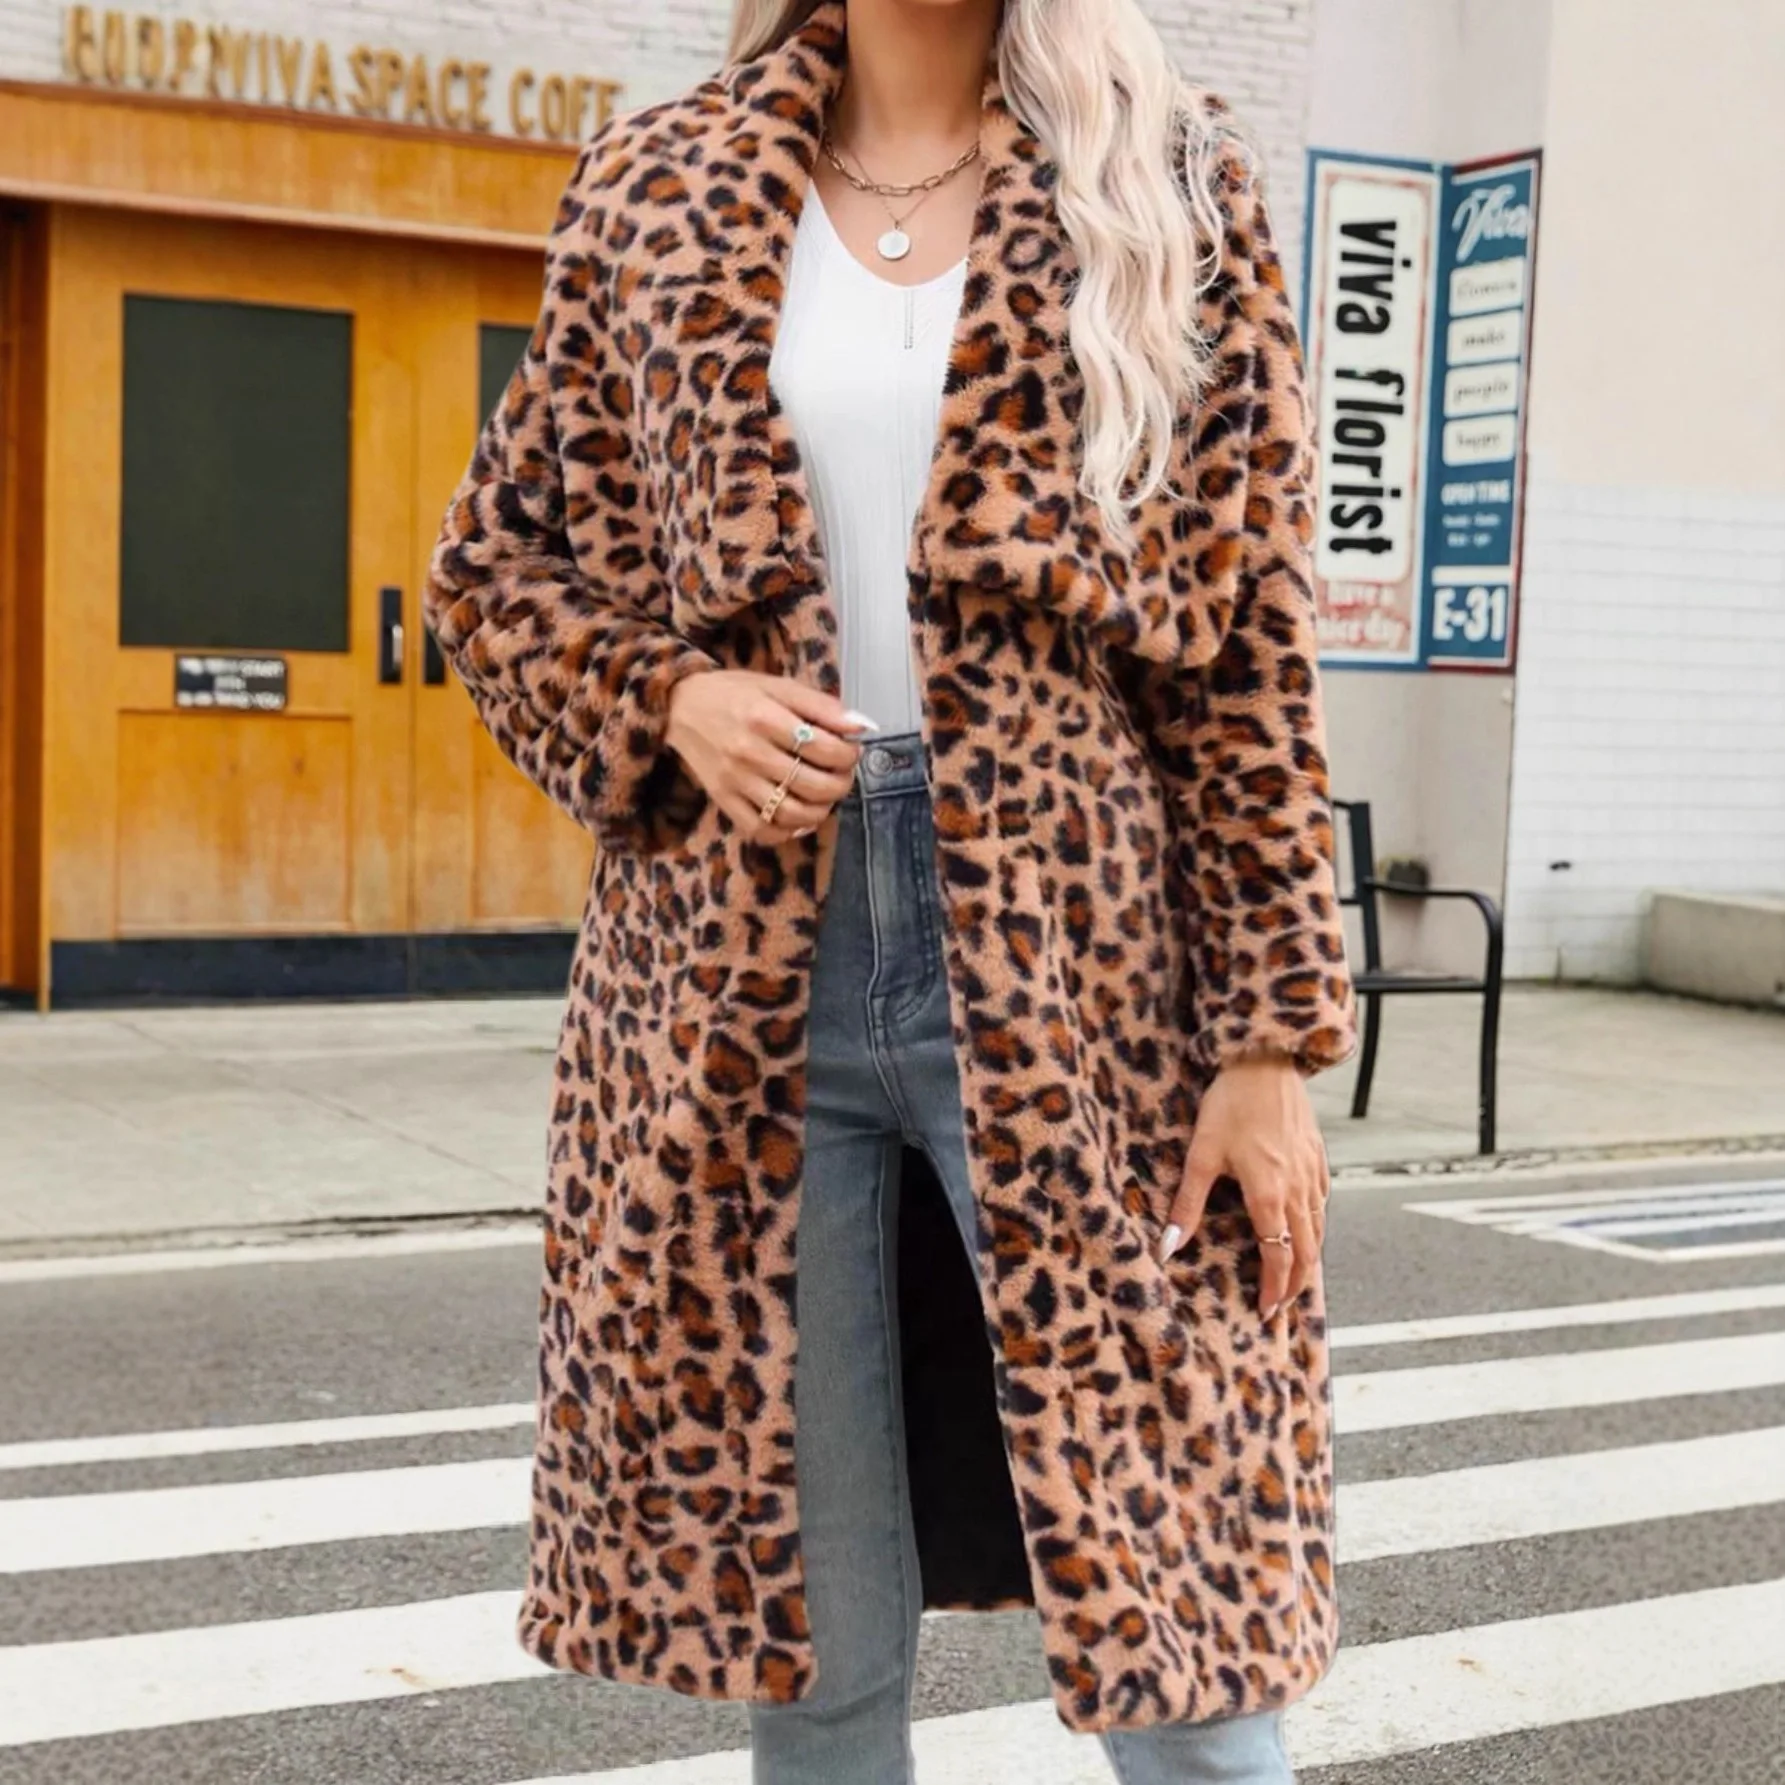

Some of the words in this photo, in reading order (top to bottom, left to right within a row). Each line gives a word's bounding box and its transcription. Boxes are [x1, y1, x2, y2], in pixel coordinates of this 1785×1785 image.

[346, 44, 492, 132] SPACE
[1335, 220, 1413, 335] viva
[1328, 368, 1406, 556] florist
[1431, 585, 1507, 643] E-31
